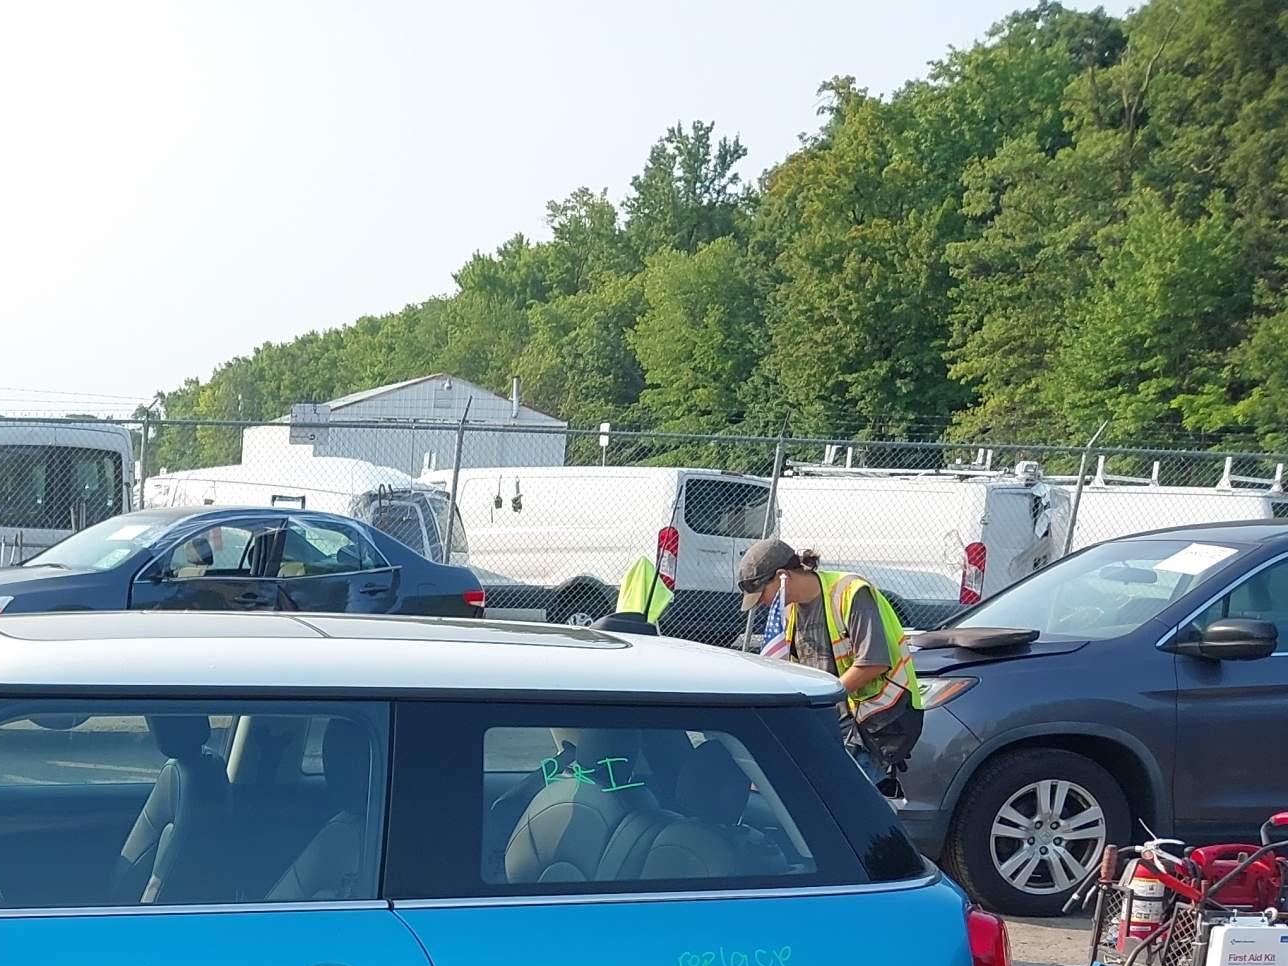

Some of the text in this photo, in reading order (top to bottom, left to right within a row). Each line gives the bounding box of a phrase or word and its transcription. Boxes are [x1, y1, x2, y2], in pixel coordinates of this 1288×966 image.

[1228, 953, 1276, 962] First Aid Kit
